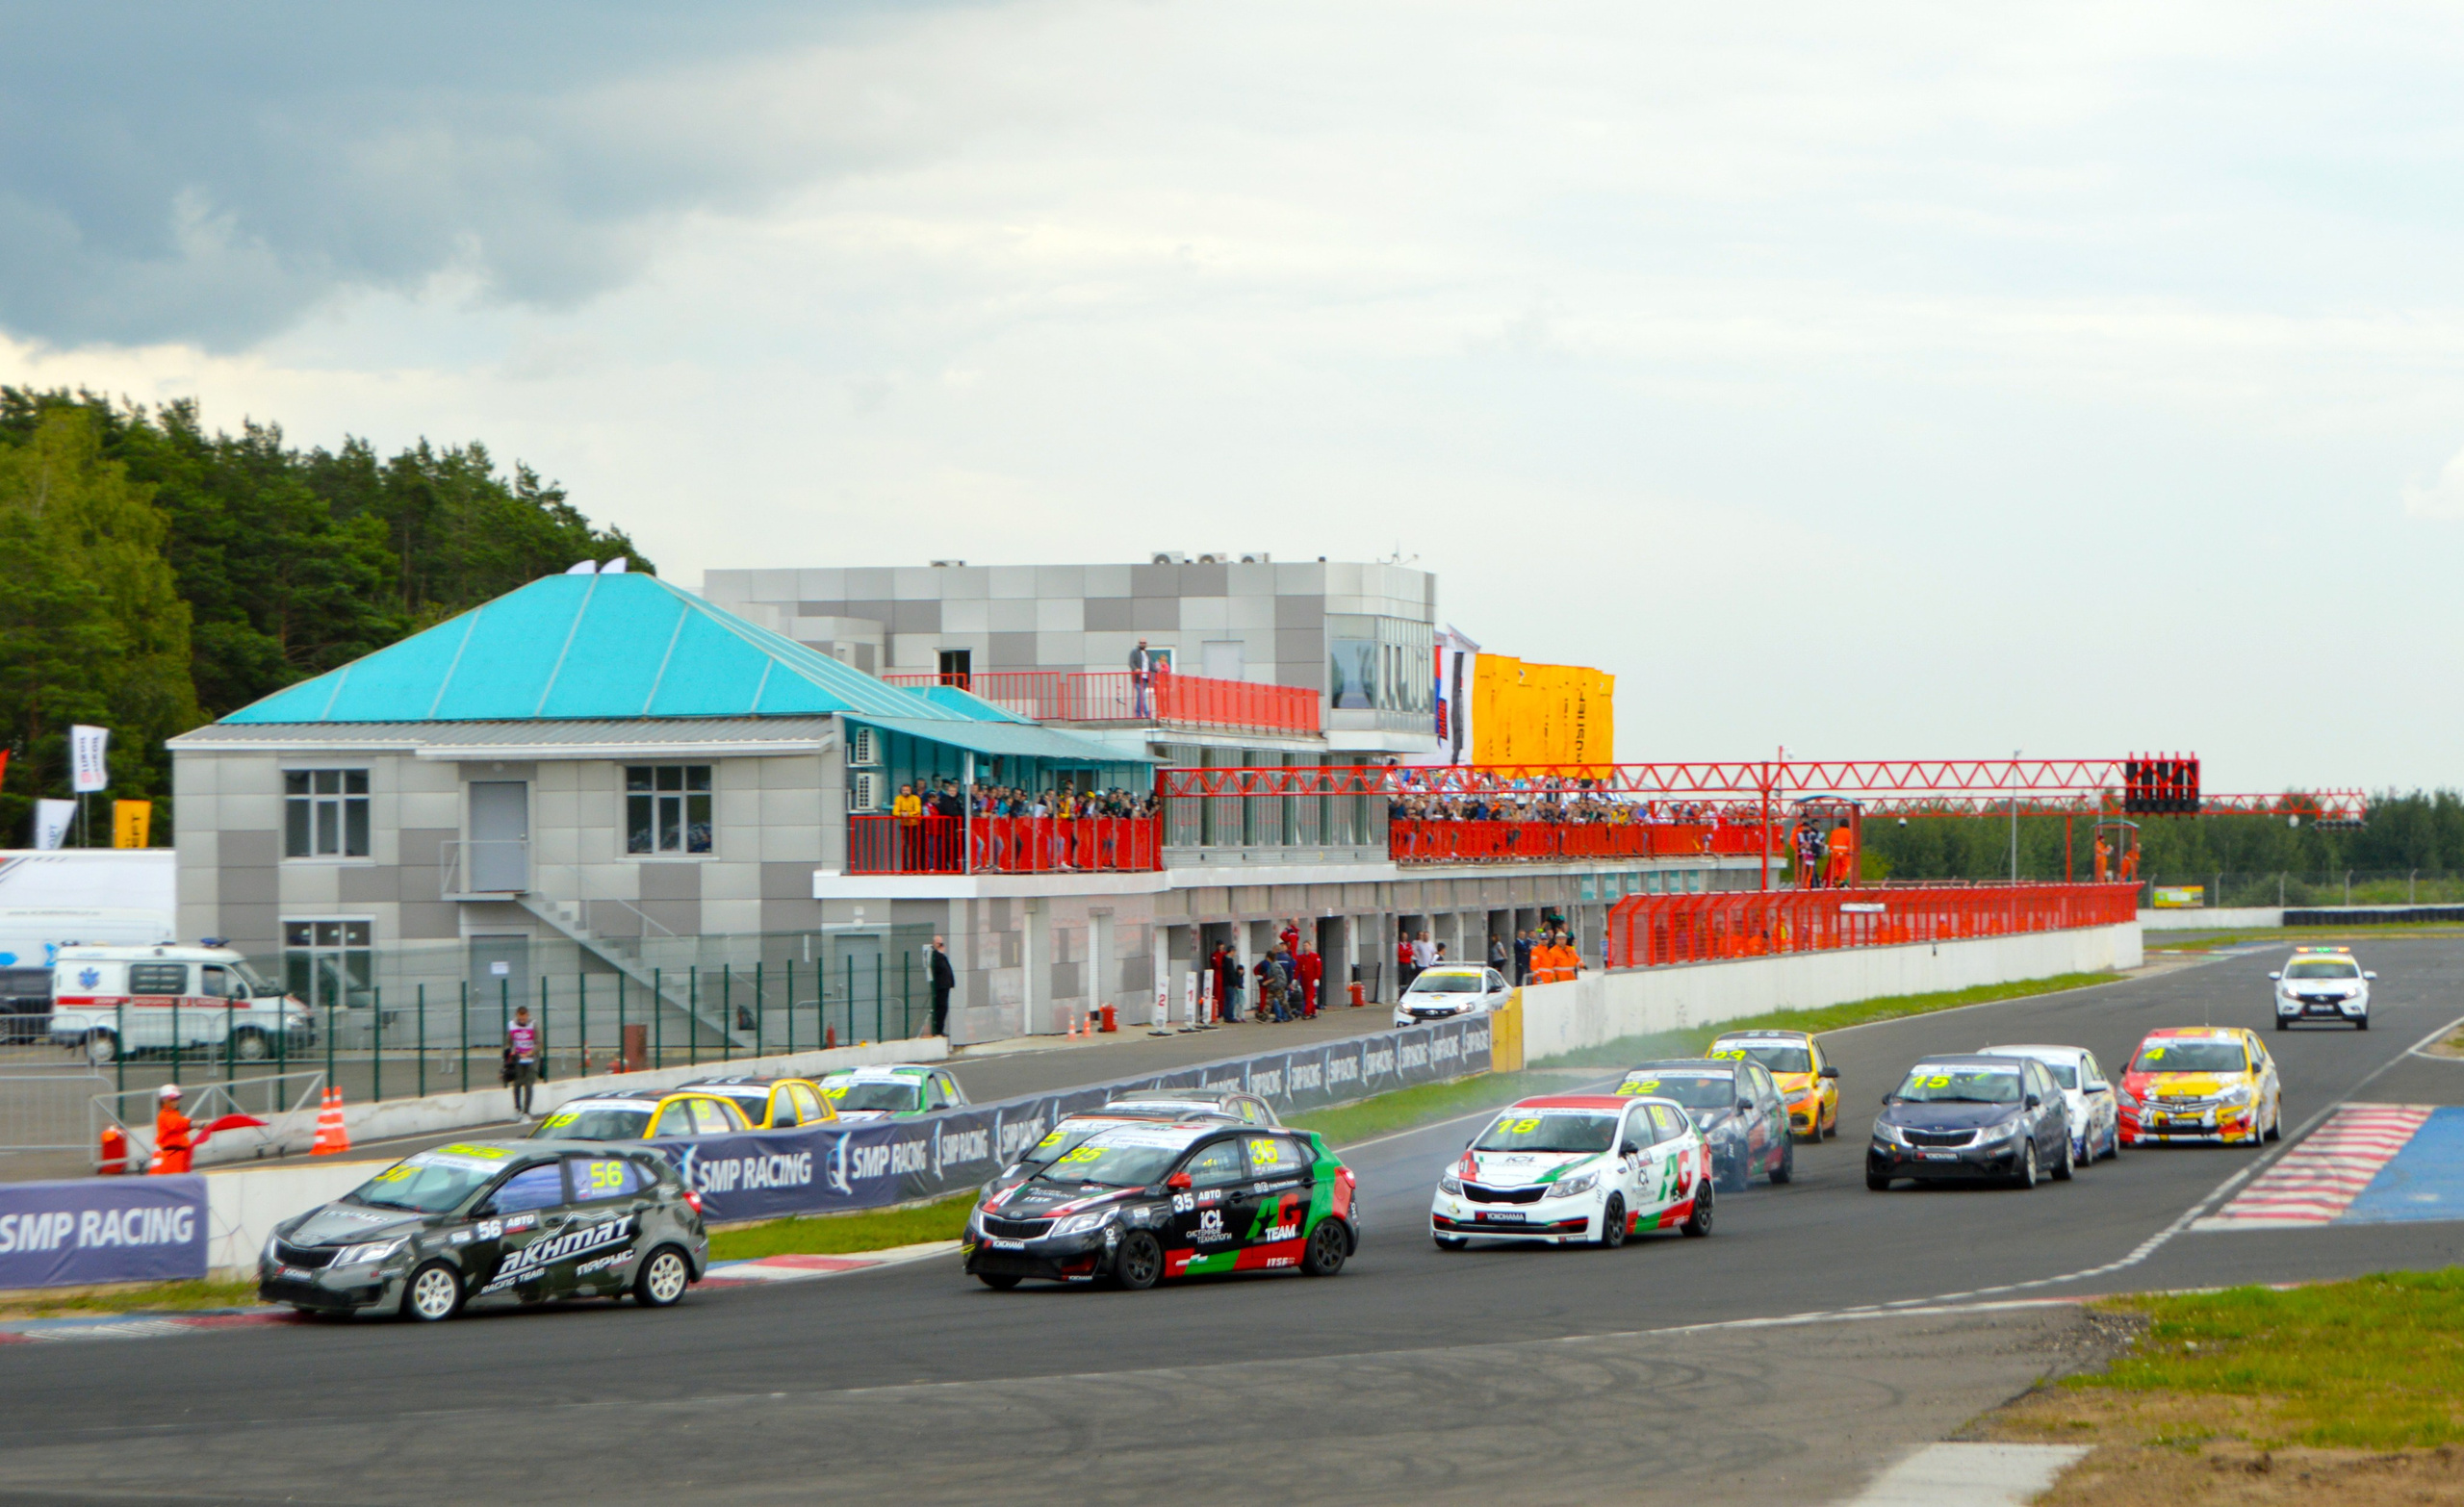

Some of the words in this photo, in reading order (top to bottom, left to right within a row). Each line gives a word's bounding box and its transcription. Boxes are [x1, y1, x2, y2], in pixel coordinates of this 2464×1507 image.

[1157, 993, 1167, 1007] 2
[1187, 989, 1194, 1002] 1
[2144, 1047, 2166, 1060] 4
[1615, 1081, 1660, 1095] 22
[1912, 1075, 1951, 1089] 15
[542, 1112, 580, 1130] 19
[1497, 1118, 1541, 1134] 18
[1649, 1106, 1666, 1127] 18
[942, 1133, 960, 1165] SMP
[960, 1129, 988, 1162] RACING
[1059, 1147, 1110, 1163] 35
[1250, 1139, 1278, 1164] 35
[852, 1145, 889, 1180] SMP
[890, 1139, 927, 1175] RACING
[374, 1164, 423, 1183] 56
[590, 1161, 624, 1189] 56
[699, 1160, 741, 1194] SMP
[743, 1152, 812, 1189] RACING
[1173, 1192, 1194, 1213] 35
[1486, 1211, 1527, 1222] YOKOHAMA
[0, 1211, 75, 1254] SMP
[78, 1205, 195, 1249] RACING
[478, 1219, 502, 1240] 56
[1265, 1223, 1296, 1242] TEAM
[992, 1239, 1025, 1250] YOKOHAMA
[576, 1248, 636, 1277] ПАРУС
[480, 1276, 517, 1295] RACING
[519, 1266, 547, 1283] TEAM
